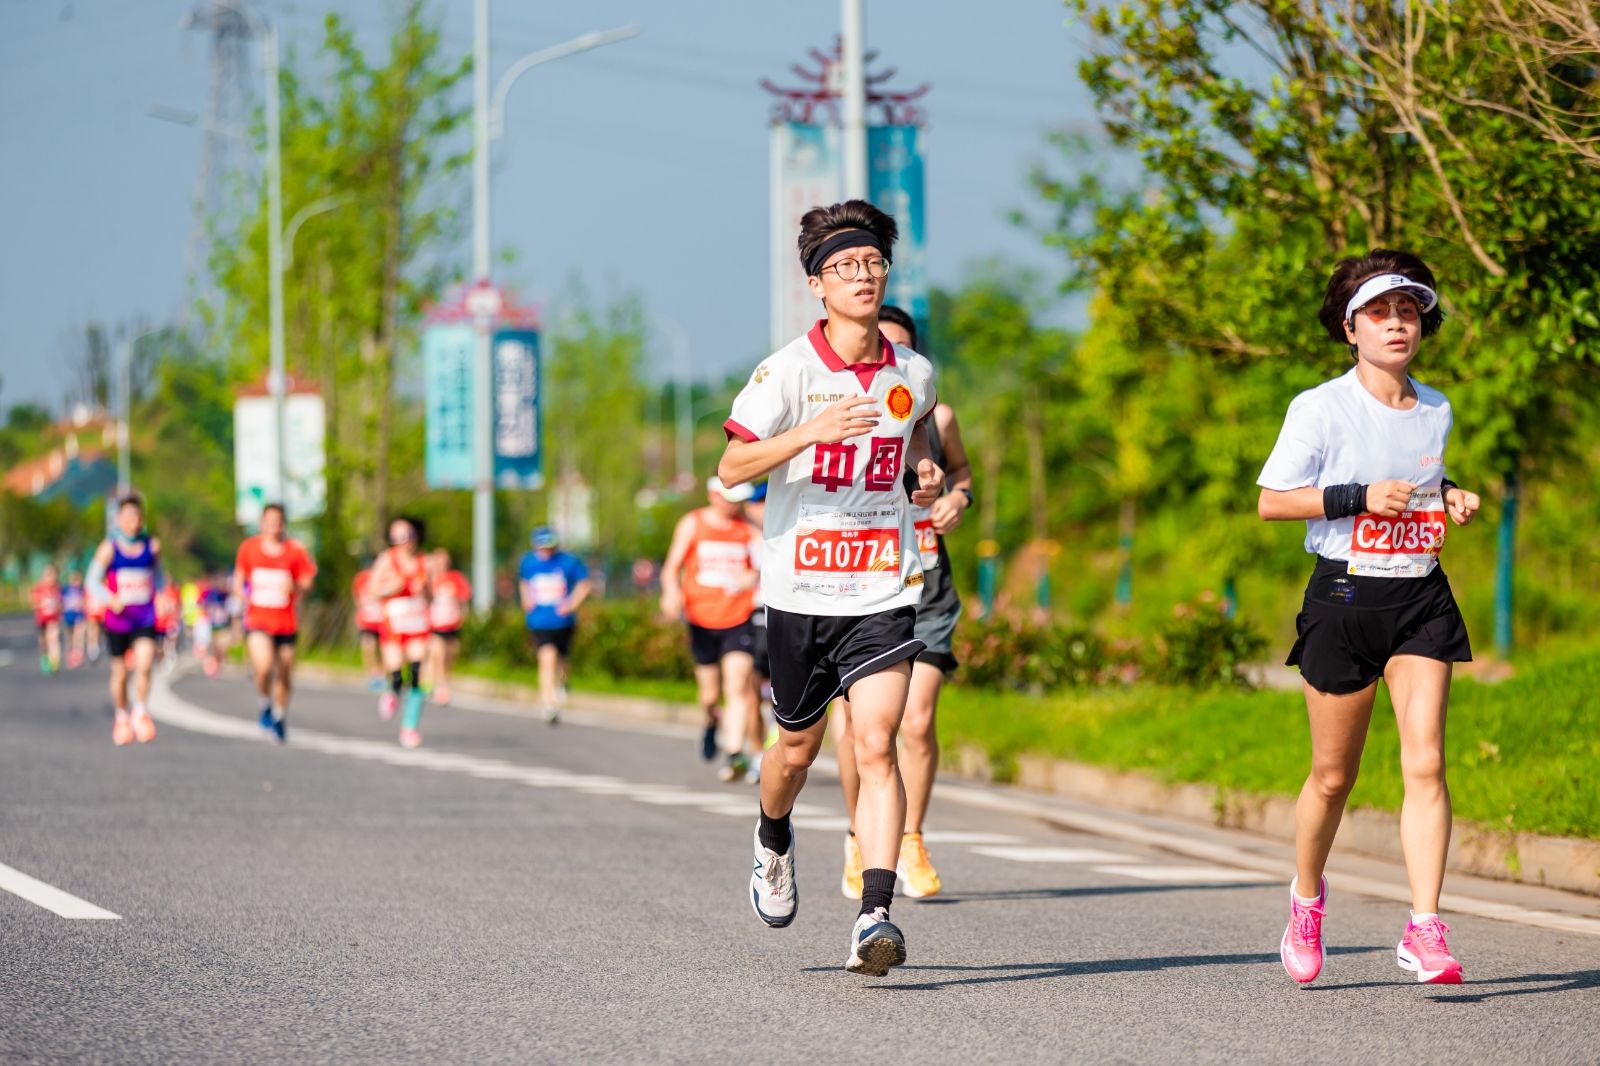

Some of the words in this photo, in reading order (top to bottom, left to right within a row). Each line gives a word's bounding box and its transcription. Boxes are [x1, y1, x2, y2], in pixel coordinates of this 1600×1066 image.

[813, 436, 904, 492] 中国
[1357, 518, 1446, 550] C20353
[799, 538, 895, 568] C10774
